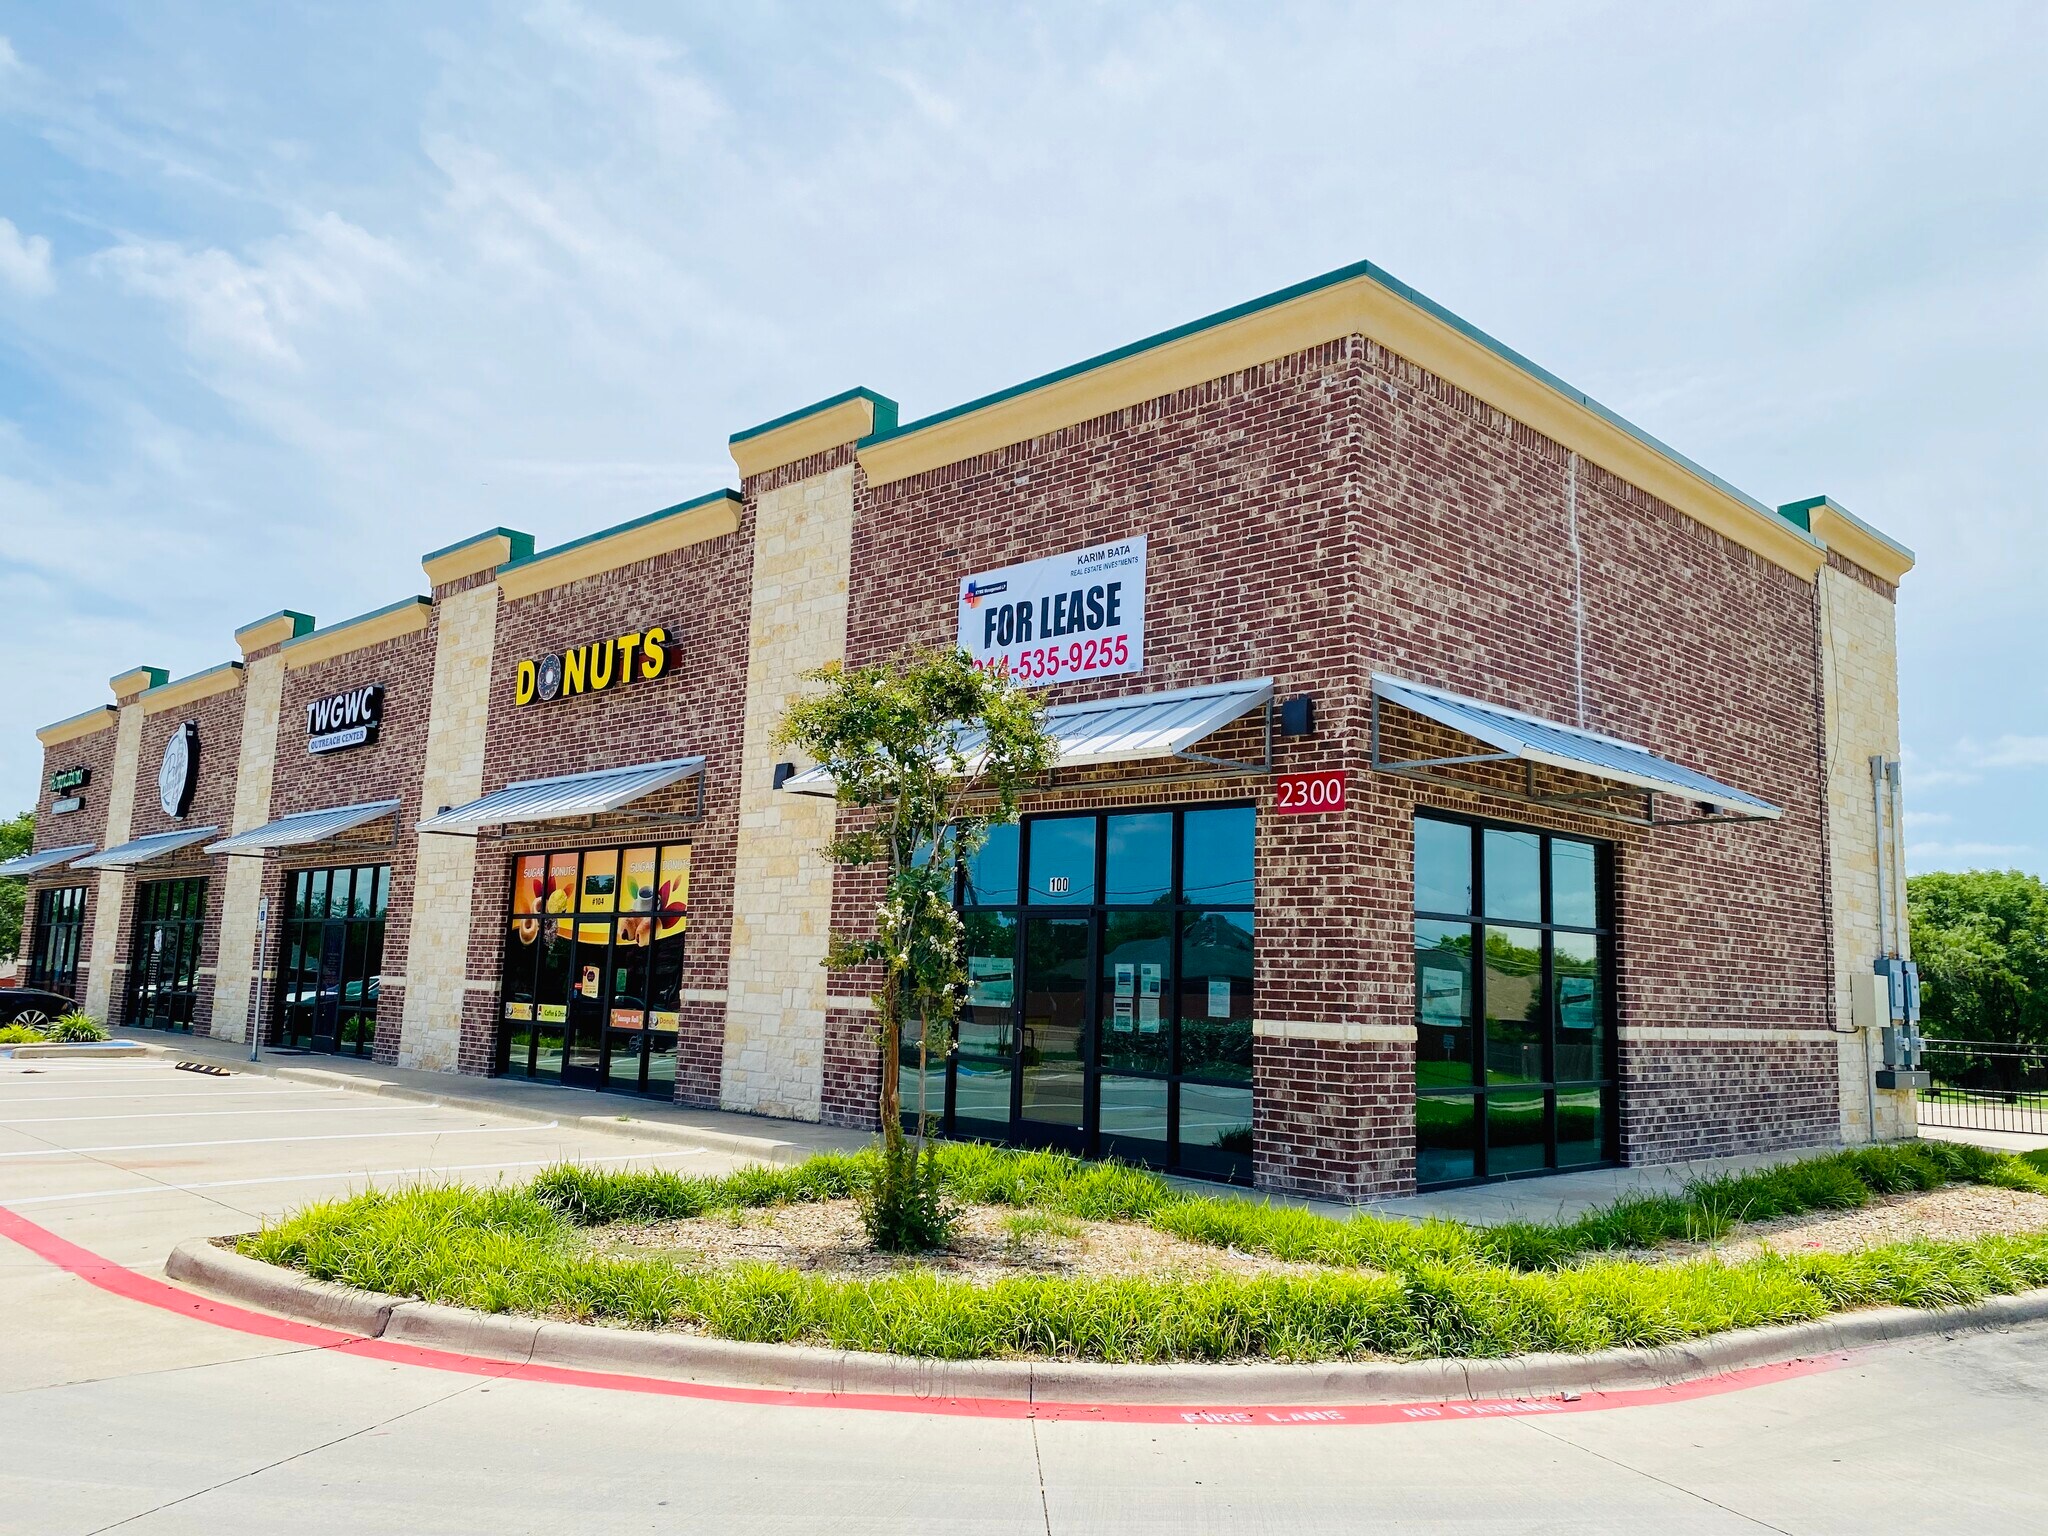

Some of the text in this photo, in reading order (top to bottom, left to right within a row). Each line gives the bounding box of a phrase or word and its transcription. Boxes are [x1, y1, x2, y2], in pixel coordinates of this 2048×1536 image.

[1077, 545, 1131, 565] KARIM BATA
[1070, 556, 1139, 577] REAL ESTATE INVESTMENTS
[984, 581, 1122, 649] FOR LEASE
[515, 626, 666, 706] DONUTS
[306, 686, 374, 734] TWGWC
[310, 730, 365, 750] OUTREACH CENTER
[1279, 778, 1341, 808] 2300
[523, 865, 576, 878] SUGAR DONUTS
[629, 858, 691, 873] SUGAR DONUTS
[1050, 877, 1069, 892] 100
[591, 897, 604, 906] #104
[659, 1016, 675, 1025] Donuts
[1180, 1410, 1347, 1424] FIRE LANE
[1401, 1403, 1565, 1418] NO PARKING
